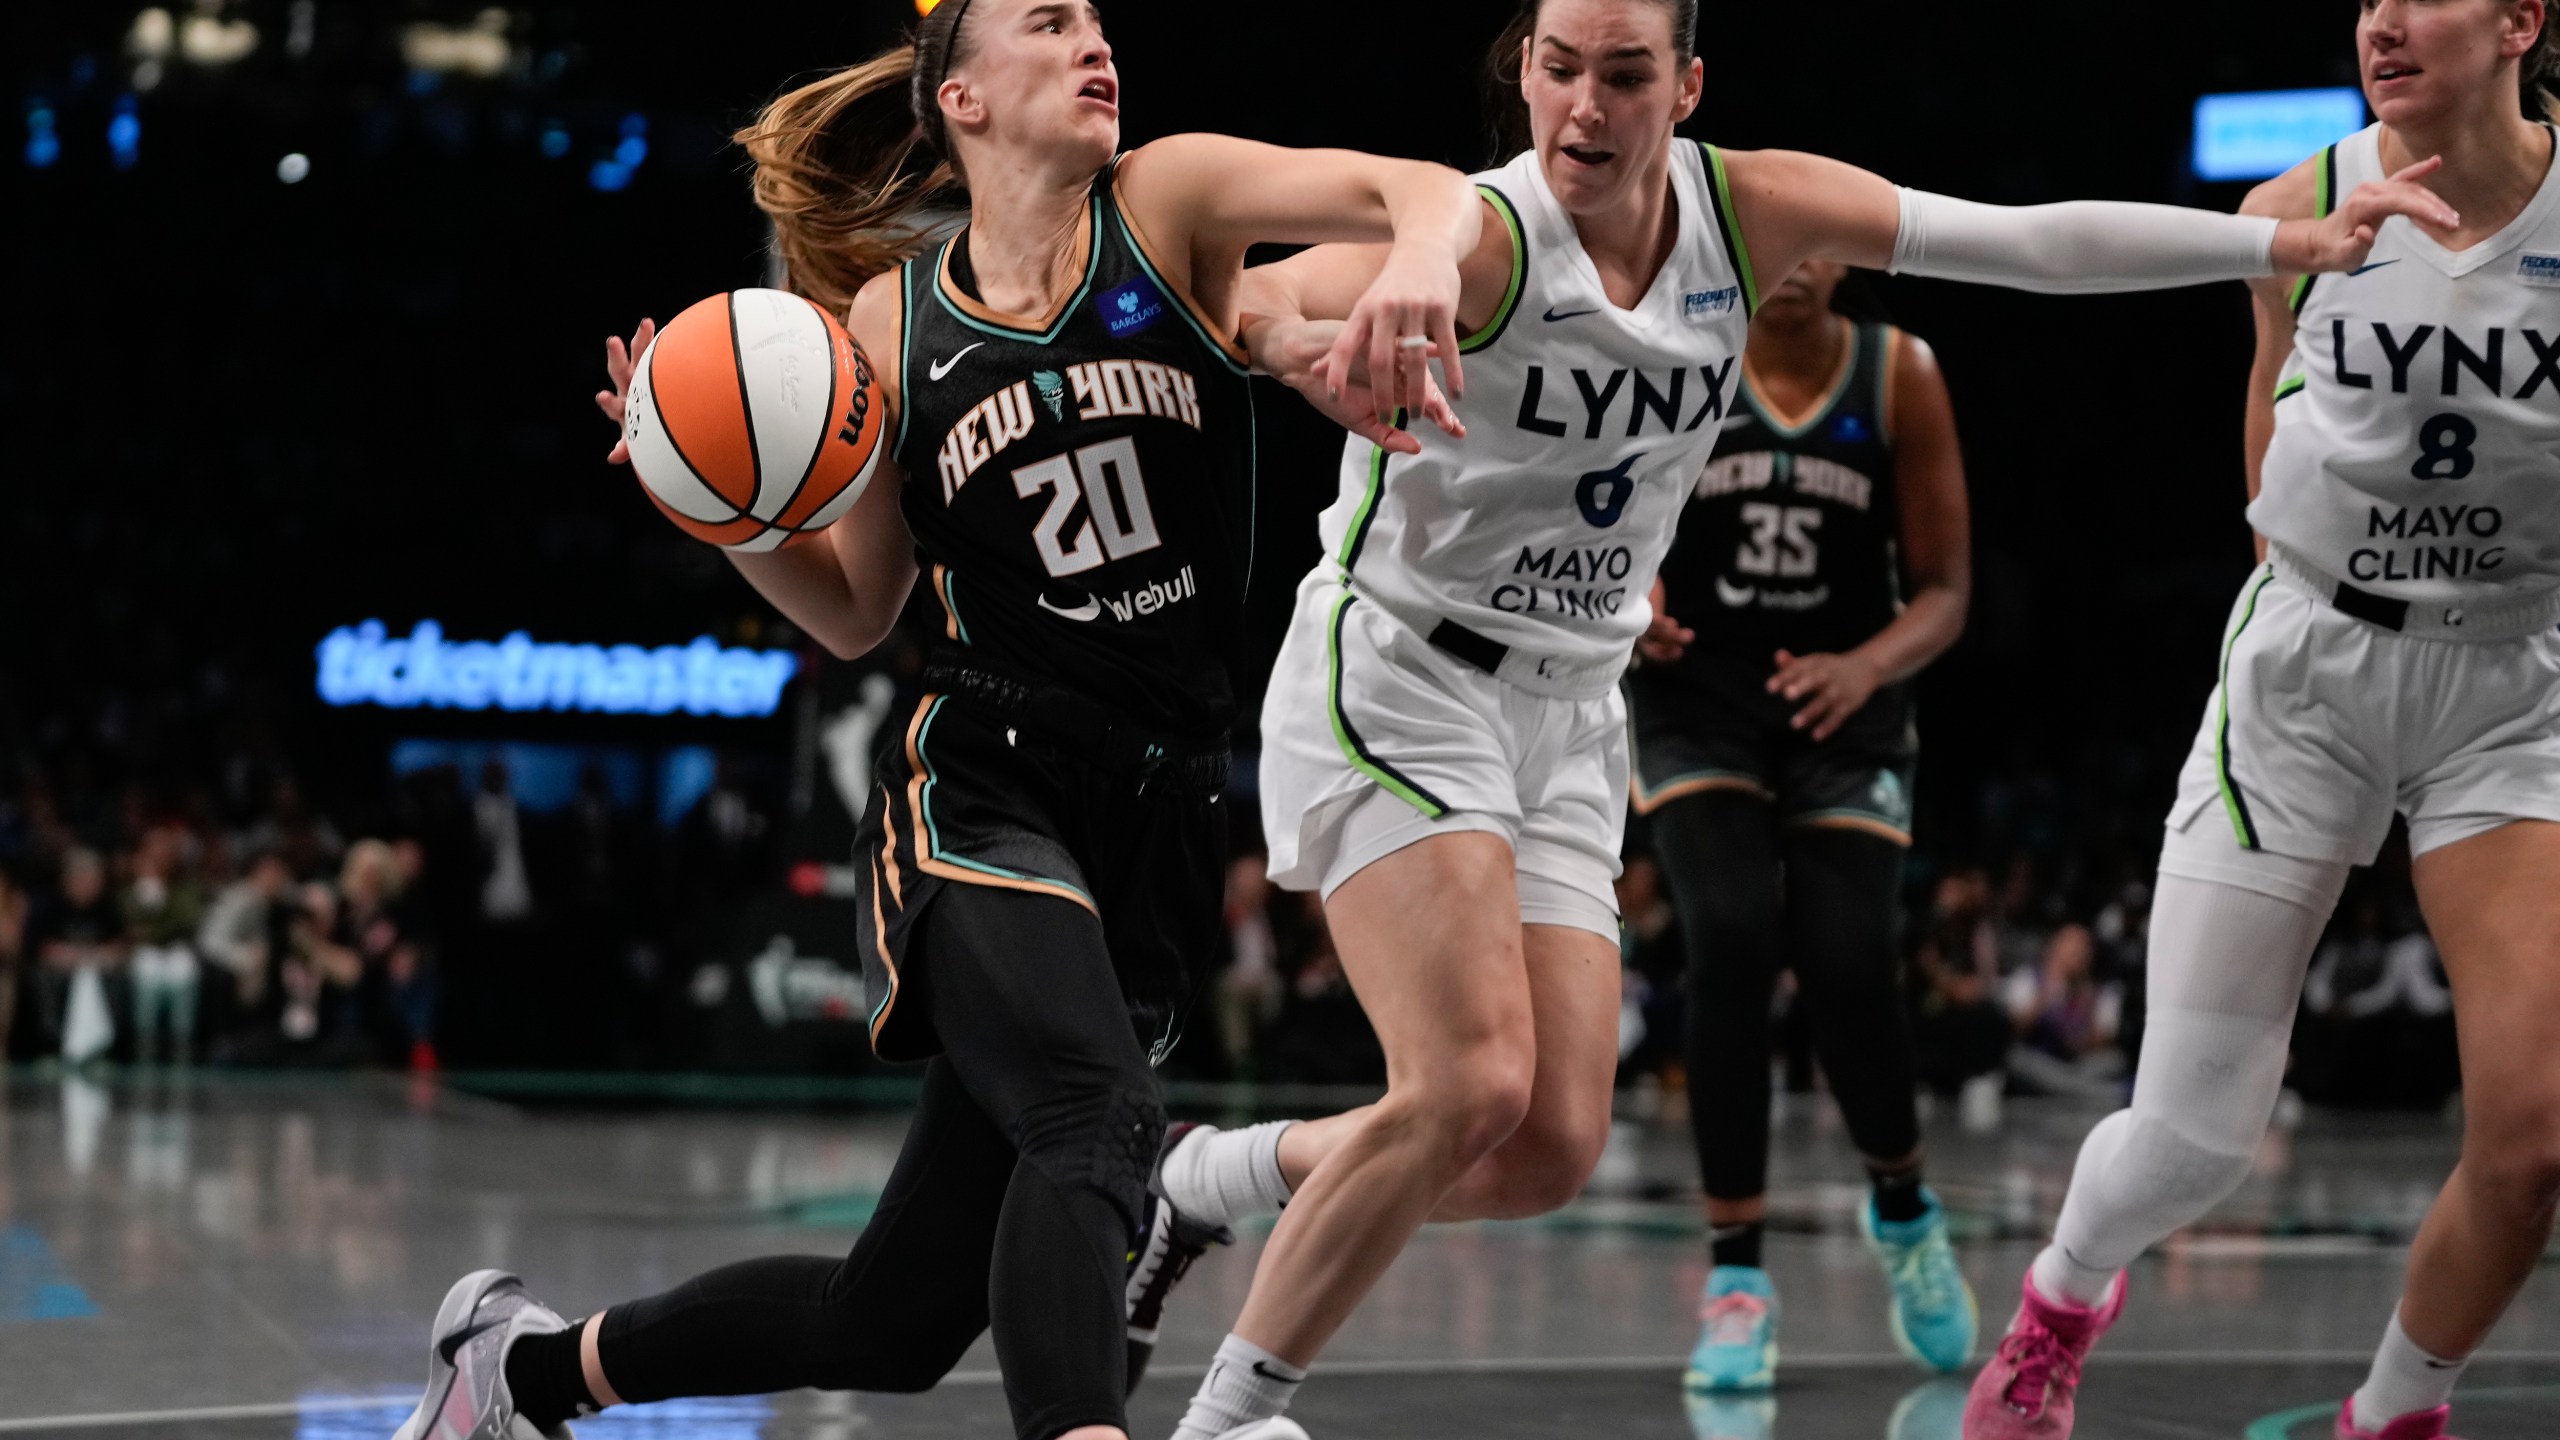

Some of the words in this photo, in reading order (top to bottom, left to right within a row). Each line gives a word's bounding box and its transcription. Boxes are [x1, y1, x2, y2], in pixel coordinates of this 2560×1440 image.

[1111, 303, 1162, 331] BARCLAYS
[2332, 319, 2560, 399] LYNX
[938, 379, 1035, 508] NEW
[1066, 359, 1201, 432] YORK
[1516, 356, 1735, 440] LYNX
[2411, 413, 2476, 480] 8
[1011, 435, 1161, 577] 20
[1575, 452, 1649, 528] 6
[2368, 505, 2502, 538] MAYO
[1513, 546, 1632, 582] MAYO
[1736, 502, 1823, 577] 35
[2348, 547, 2506, 581] CLINIC
[1103, 564, 1196, 622] Webull
[1491, 584, 1626, 620] CLINIC
[316, 618, 798, 717] ticketmaster
